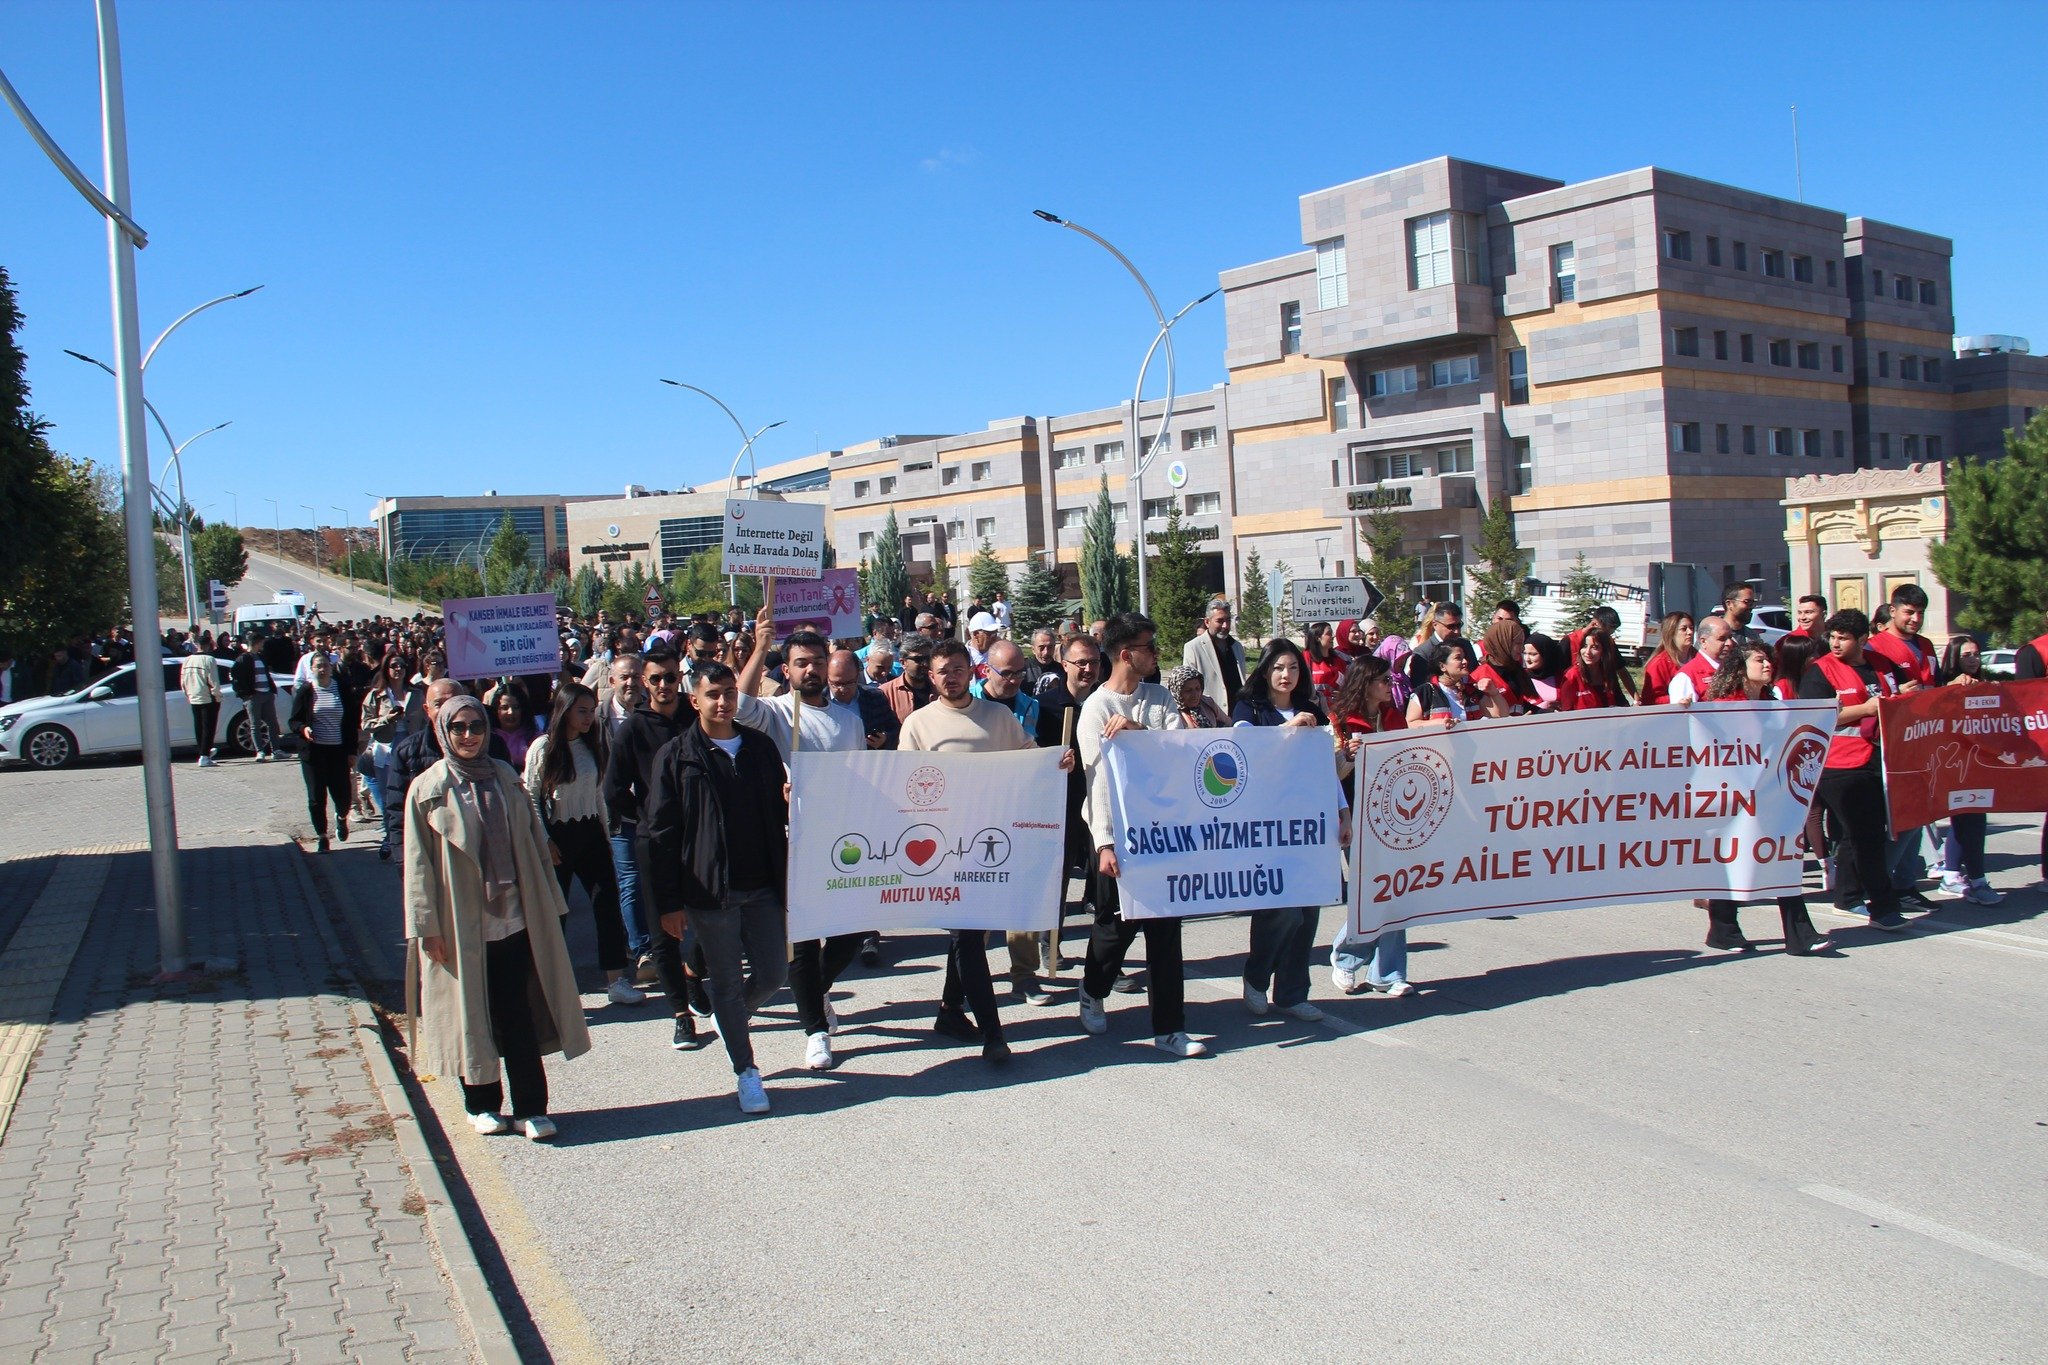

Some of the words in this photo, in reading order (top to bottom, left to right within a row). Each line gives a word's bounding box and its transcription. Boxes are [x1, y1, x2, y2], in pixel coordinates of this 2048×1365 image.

[1347, 487, 1412, 510] DEKNLIK
[736, 523, 785, 540] İnternette
[788, 529, 813, 544] Değil
[728, 543, 750, 557] Açık
[753, 544, 789, 557] Havada
[792, 547, 819, 561] Dolaş
[729, 563, 736, 573] İL
[738, 563, 767, 575] SAĞLIK
[769, 565, 817, 577] MÜDÜRLÜĞÜ
[773, 590, 798, 604] rken
[800, 588, 821, 601] Tanı
[1305, 584, 1320, 593] Ahi
[1324, 584, 1350, 592] Evran
[1301, 596, 1355, 606] Üniversitesi
[469, 607, 495, 621] KANSER
[495, 606, 520, 620] İHMALE
[521, 605, 549, 618] GELMEZ!
[650, 607, 659, 615] 30
[1296, 608, 1321, 618] Ziraat
[1324, 607, 1363, 616] Fakültesi
[480, 624, 503, 634] TARAMA
[504, 622, 515, 633] İÇİN
[501, 637, 516, 652] BİR
[517, 635, 536, 650] GÜN
[1903, 719, 1944, 742] DÜNYA
[1951, 713, 2022, 736] YÜRÜYÜŞ
[1470, 760, 1507, 785] EN
[1516, 746, 1612, 780] BÜYÜK
[1619, 738, 1770, 770] AİLEMİZİN,
[1388, 768, 1407, 788] SOSYAL
[1127, 821, 1198, 856] SAĞLIK
[1200, 811, 1326, 851] HİZMETLERİ
[954, 871, 997, 884] HAREKET
[999, 871, 1010, 883] ET
[1372, 860, 1444, 903] 2025
[1452, 846, 1531, 885] AİLE
[1543, 843, 1606, 875] YILI
[1620, 837, 1739, 869] KUTLU
[826, 877, 866, 891] SAĞLIKLI
[868, 874, 902, 887] BESLEN
[1167, 863, 1284, 903] TOPLULUĞU
[880, 887, 925, 904] MUTLU
[928, 886, 960, 906] YAŞA
